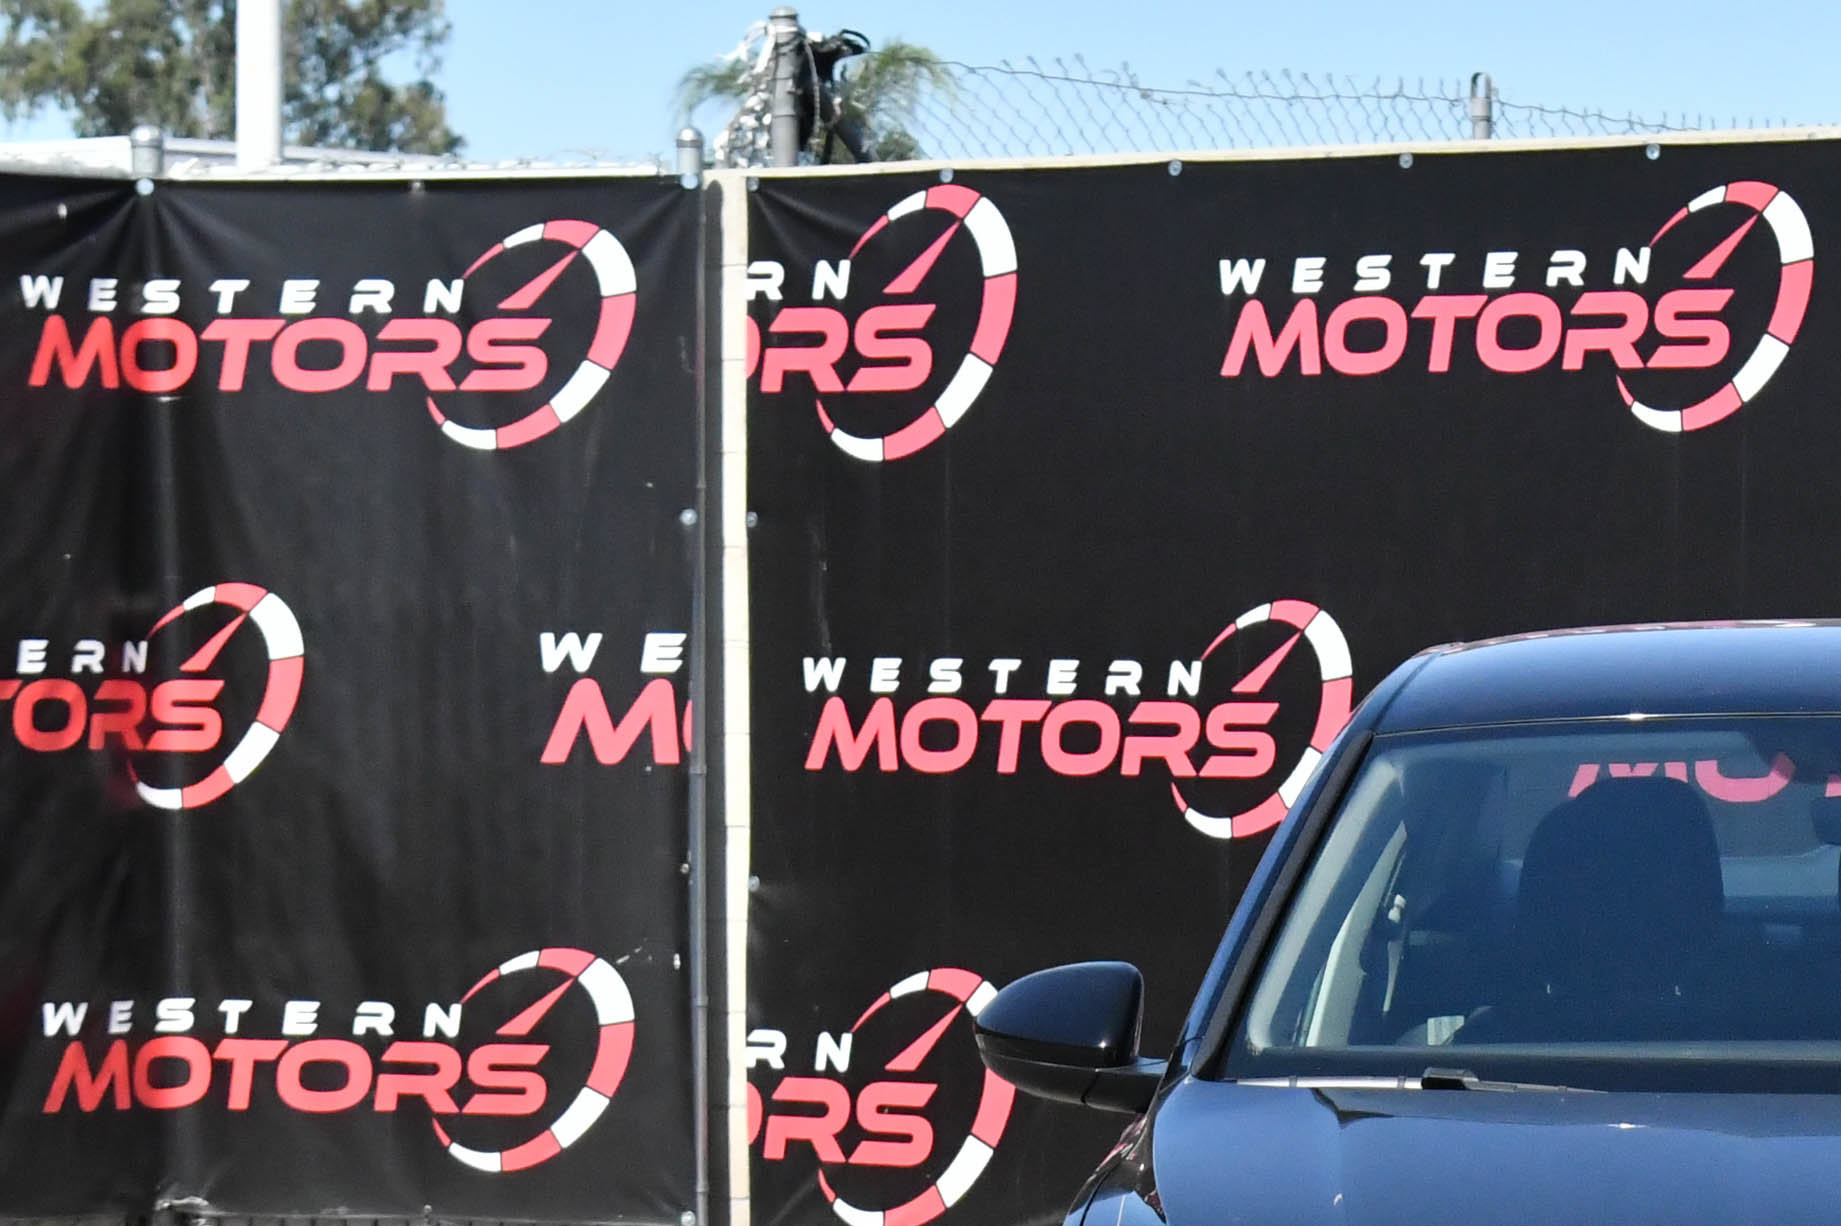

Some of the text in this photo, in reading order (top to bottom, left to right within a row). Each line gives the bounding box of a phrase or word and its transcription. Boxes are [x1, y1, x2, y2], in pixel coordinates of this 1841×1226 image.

[20, 274, 466, 316] WESTERN
[1219, 246, 1652, 296] WESTERN
[27, 315, 553, 394] MOTORS
[746, 303, 937, 394] RS
[1220, 287, 1736, 379] MOTORS
[802, 656, 1204, 698] WESTERN
[540, 676, 694, 767] M
[804, 695, 1281, 780] MOTORS
[42, 997, 463, 1039] WESTERN
[43, 1035, 551, 1117] MOTORS
[746, 1075, 939, 1169] RS
